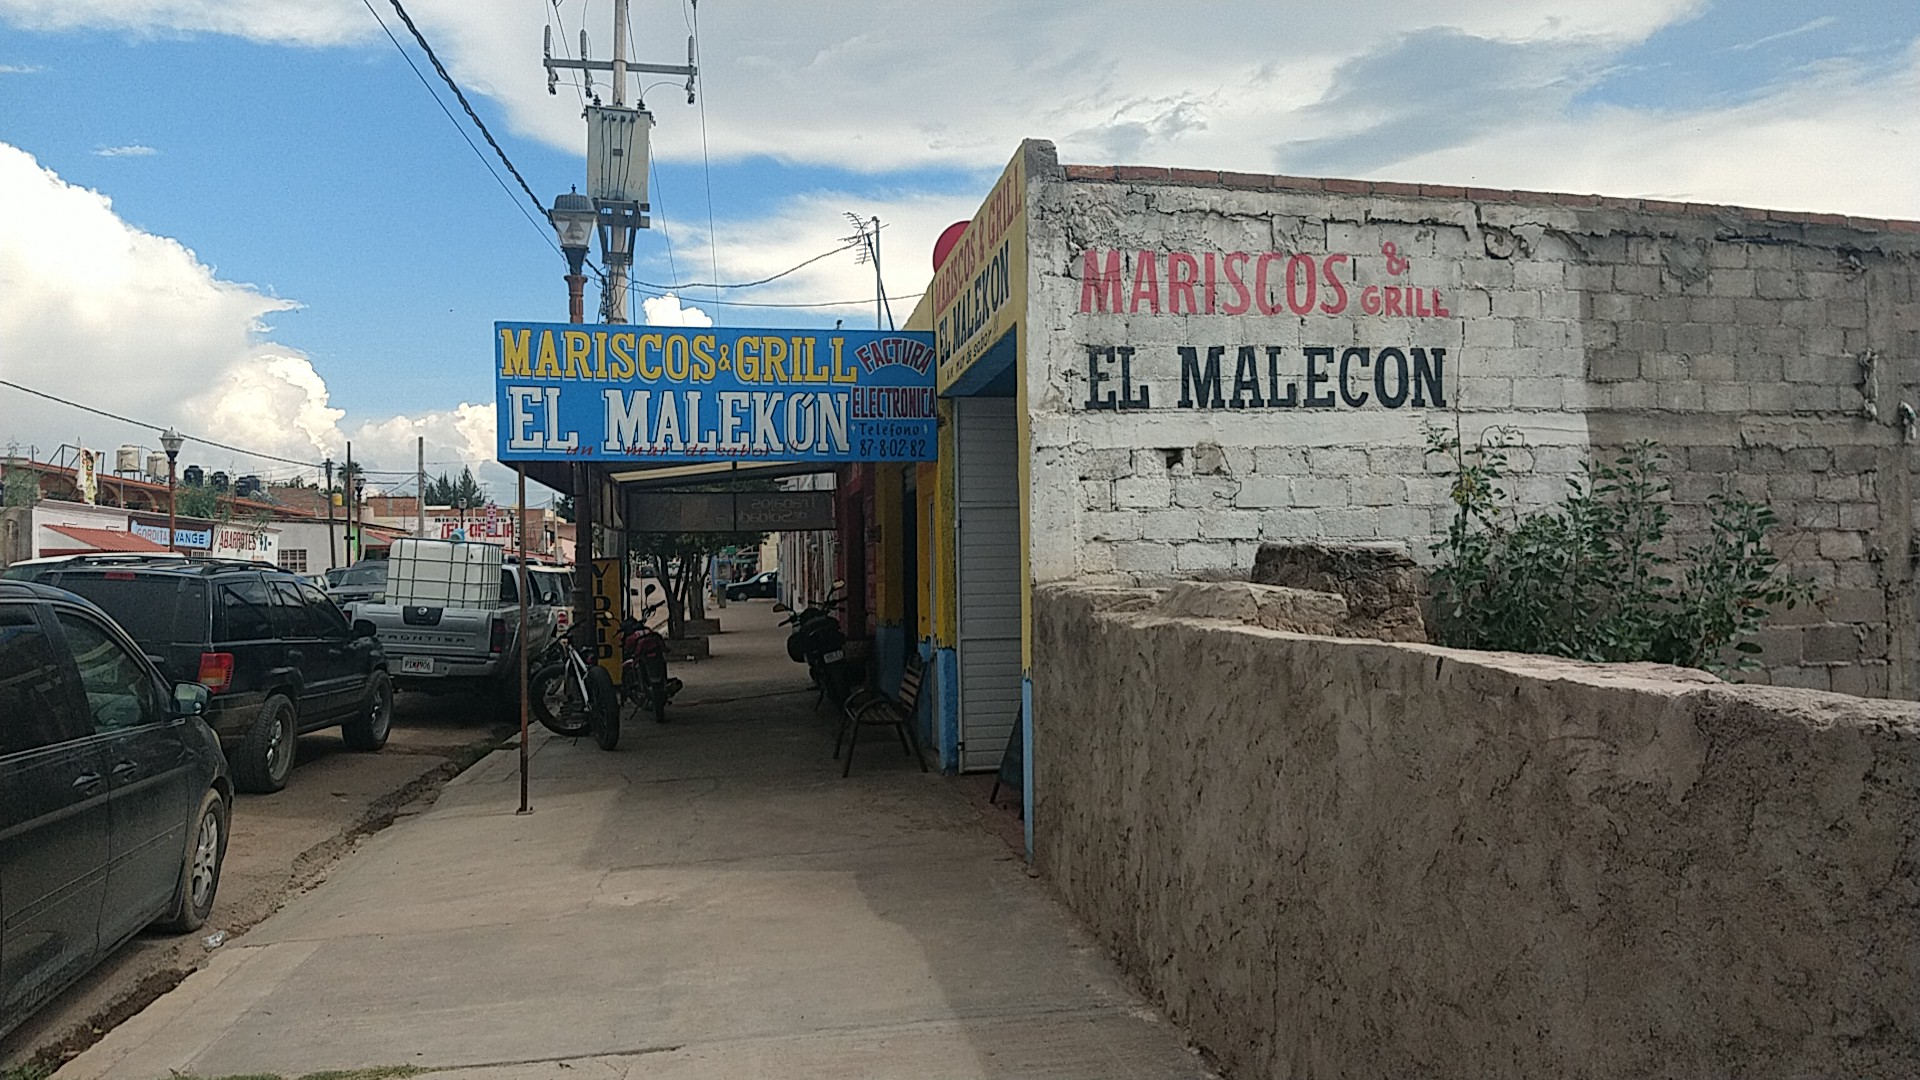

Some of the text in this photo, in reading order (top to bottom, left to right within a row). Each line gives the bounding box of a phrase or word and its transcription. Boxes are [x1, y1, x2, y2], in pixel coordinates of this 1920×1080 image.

[935, 227, 976, 316] MARISCOS
[988, 163, 1022, 250] GRILL
[938, 238, 1010, 368] EL MALEKON
[1079, 240, 1450, 318] MARISCOS & GRILL
[854, 337, 936, 377] FACTURA
[1084, 345, 1448, 410] EL MALECON
[507, 386, 851, 456] EL MALEKÓN
[850, 385, 938, 420] ELECTRONICA
[859, 421, 920, 438] Teléfono
[565, 444, 593, 455] un
[625, 444, 669, 456] mar
[685, 443, 708, 457] de
